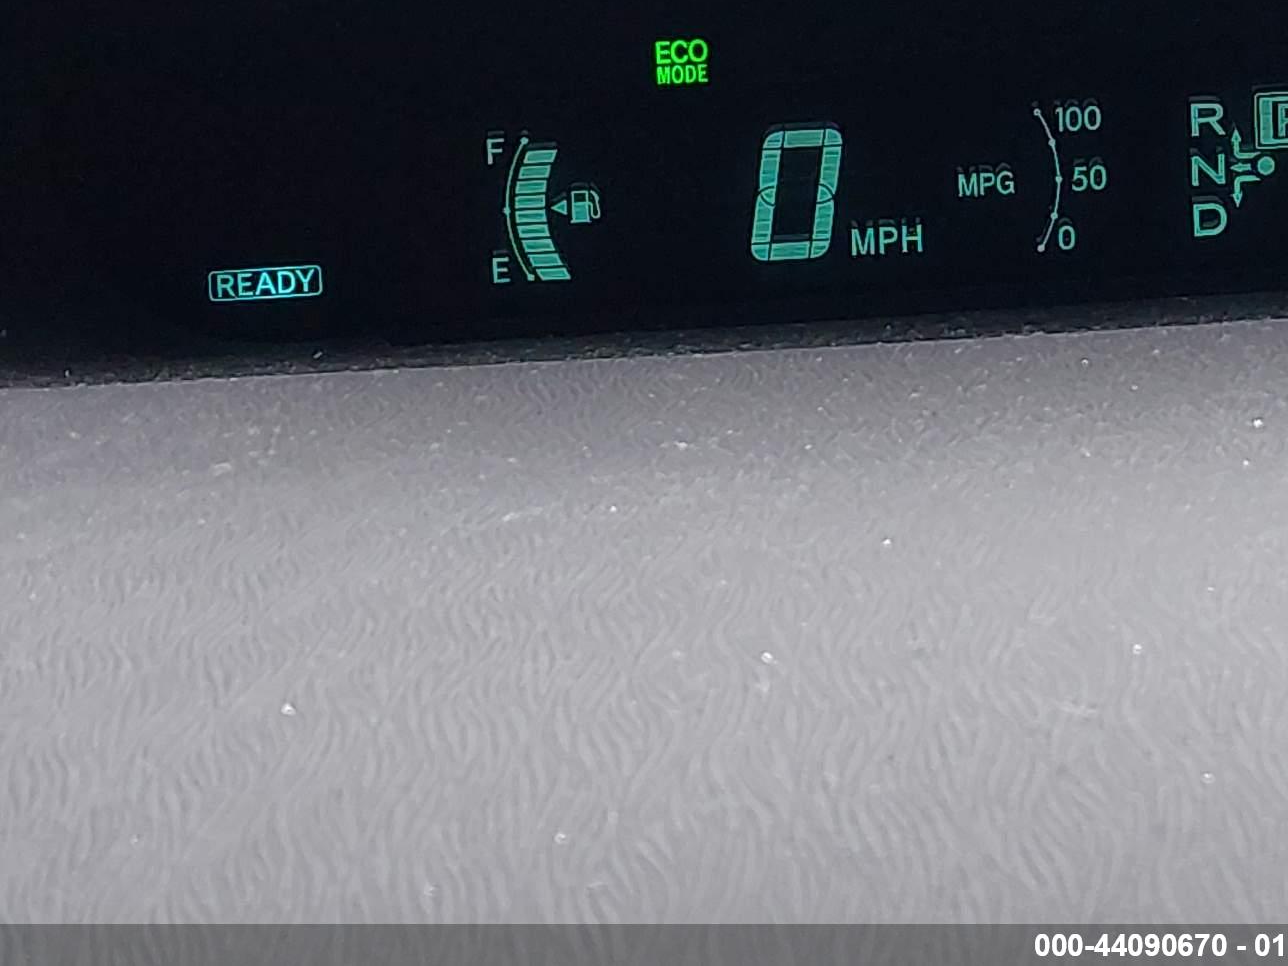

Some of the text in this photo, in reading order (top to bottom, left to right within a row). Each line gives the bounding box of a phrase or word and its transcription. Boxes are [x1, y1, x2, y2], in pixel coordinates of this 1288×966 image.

[655, 39, 708, 64] ECO
[655, 64, 709, 85] MODE
[1055, 105, 1102, 132] 100
[1190, 103, 1226, 137] R
[486, 138, 505, 166] F
[1071, 165, 1107, 192] 50
[1190, 153, 1226, 187] N
[751, 128, 843, 261] 0
[957, 171, 1016, 197] MPG
[1192, 202, 1228, 237] D
[851, 224, 924, 256] MPH
[1058, 225, 1077, 250] 0
[216, 269, 316, 298] READY
[492, 257, 511, 284] E
